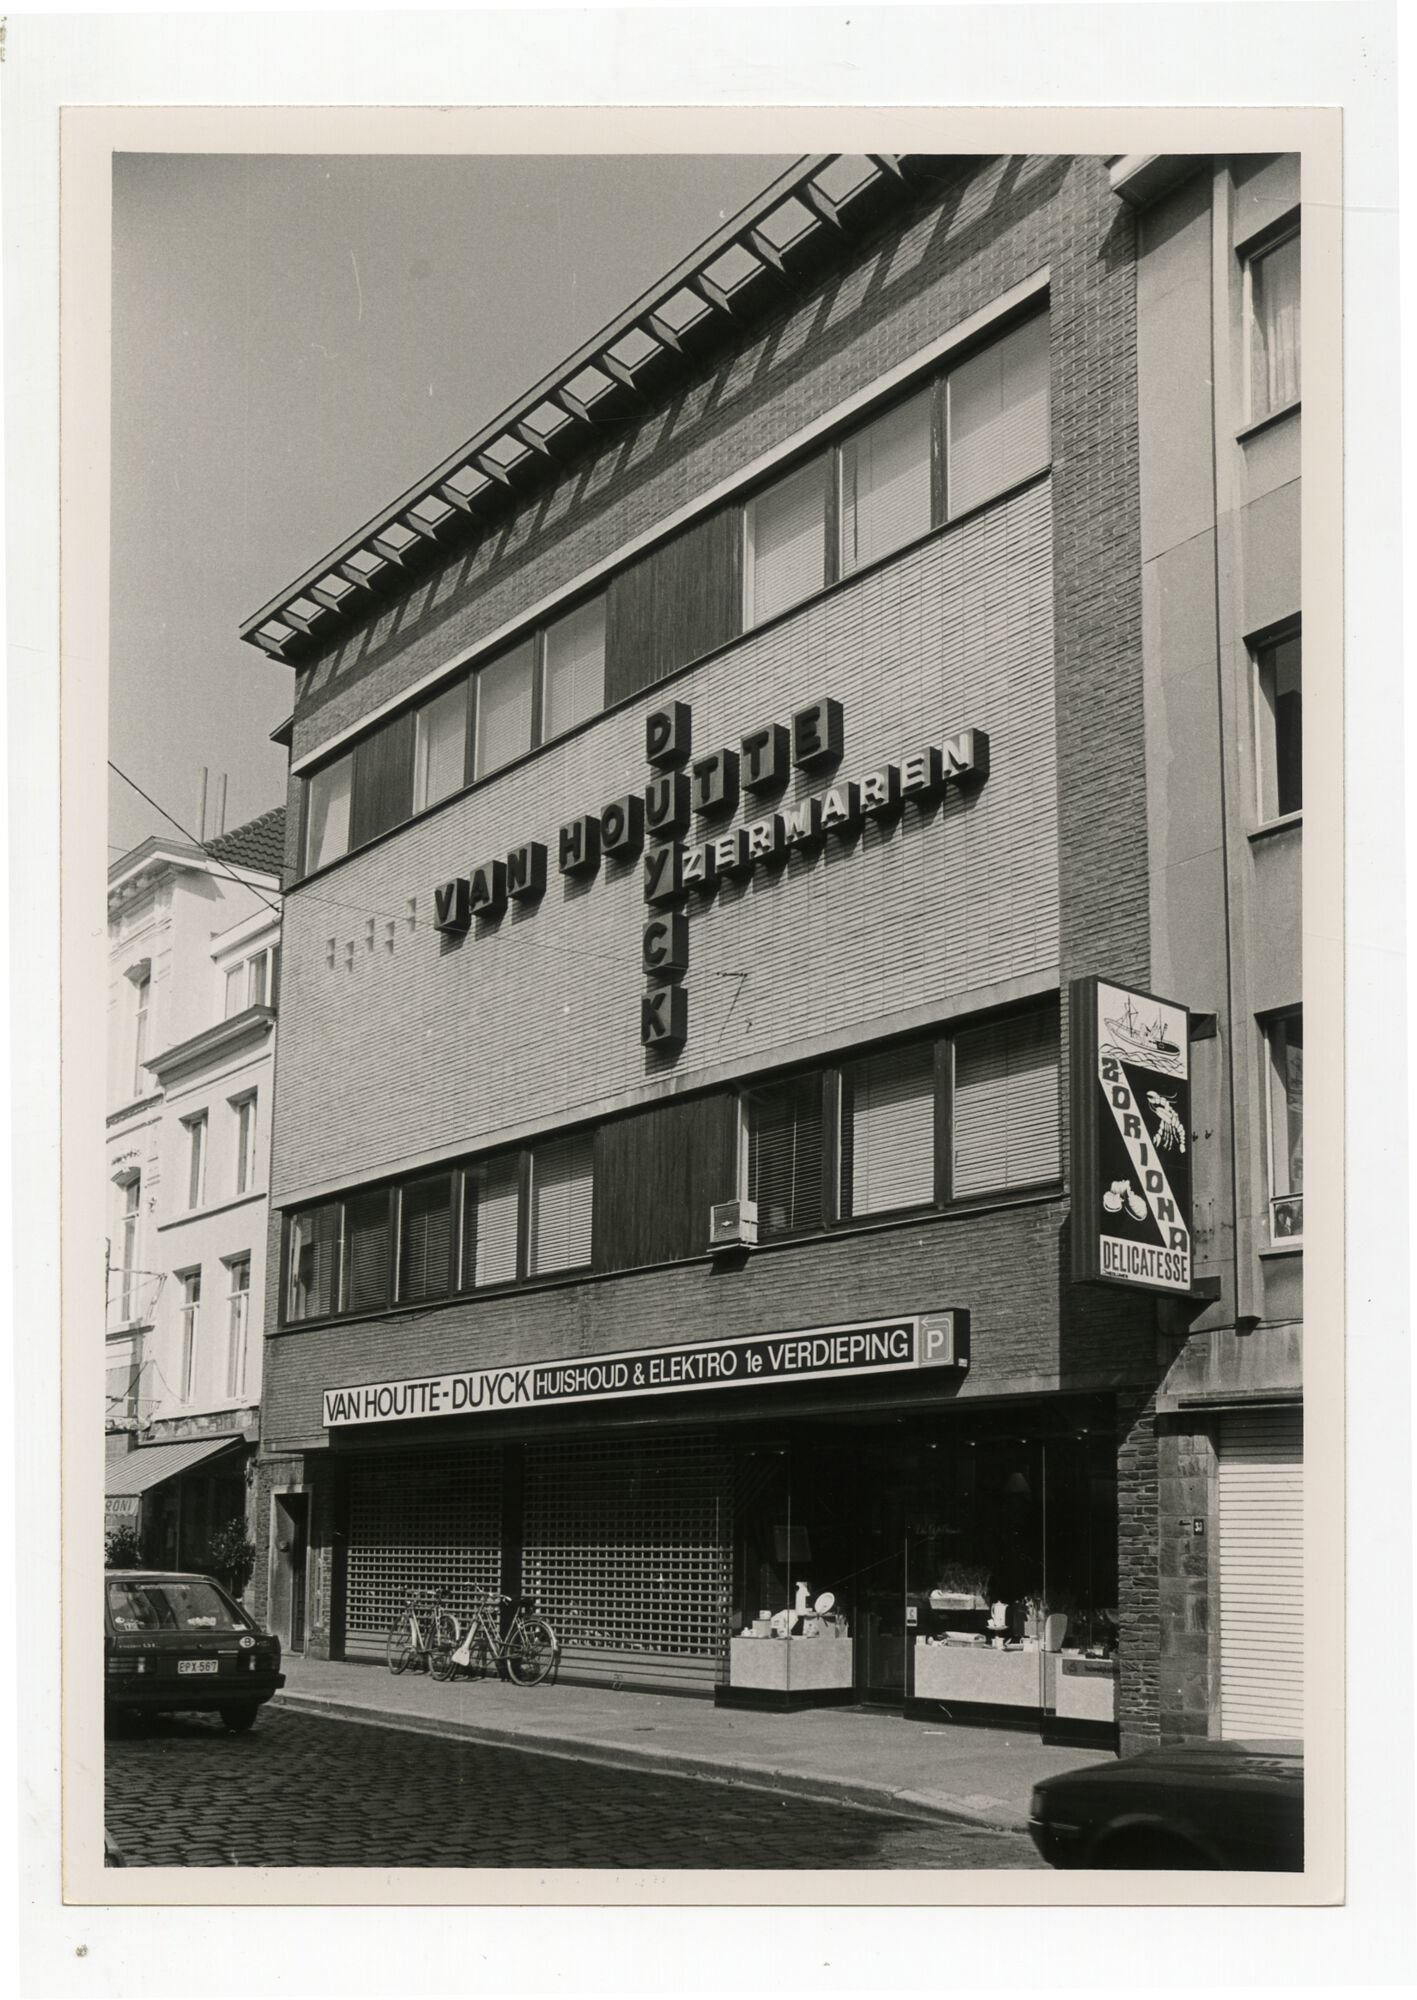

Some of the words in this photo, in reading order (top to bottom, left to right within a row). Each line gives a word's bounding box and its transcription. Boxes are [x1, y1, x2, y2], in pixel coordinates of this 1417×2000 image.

[434, 845, 530, 930] VAN
[559, 702, 828, 873] HOUTTE
[642, 704, 678, 1044] DUYCK
[1102, 1240, 1188, 1284] DELICATESSE
[325, 1391, 361, 1422] VAN
[536, 1363, 628, 1395] HUISHOUD
[633, 1365, 645, 1385] &
[649, 1349, 737, 1384] ELEKTRO
[745, 1350, 762, 1373] 1e
[767, 1329, 909, 1371] VERDIEPING
[926, 1329, 945, 1358] P
